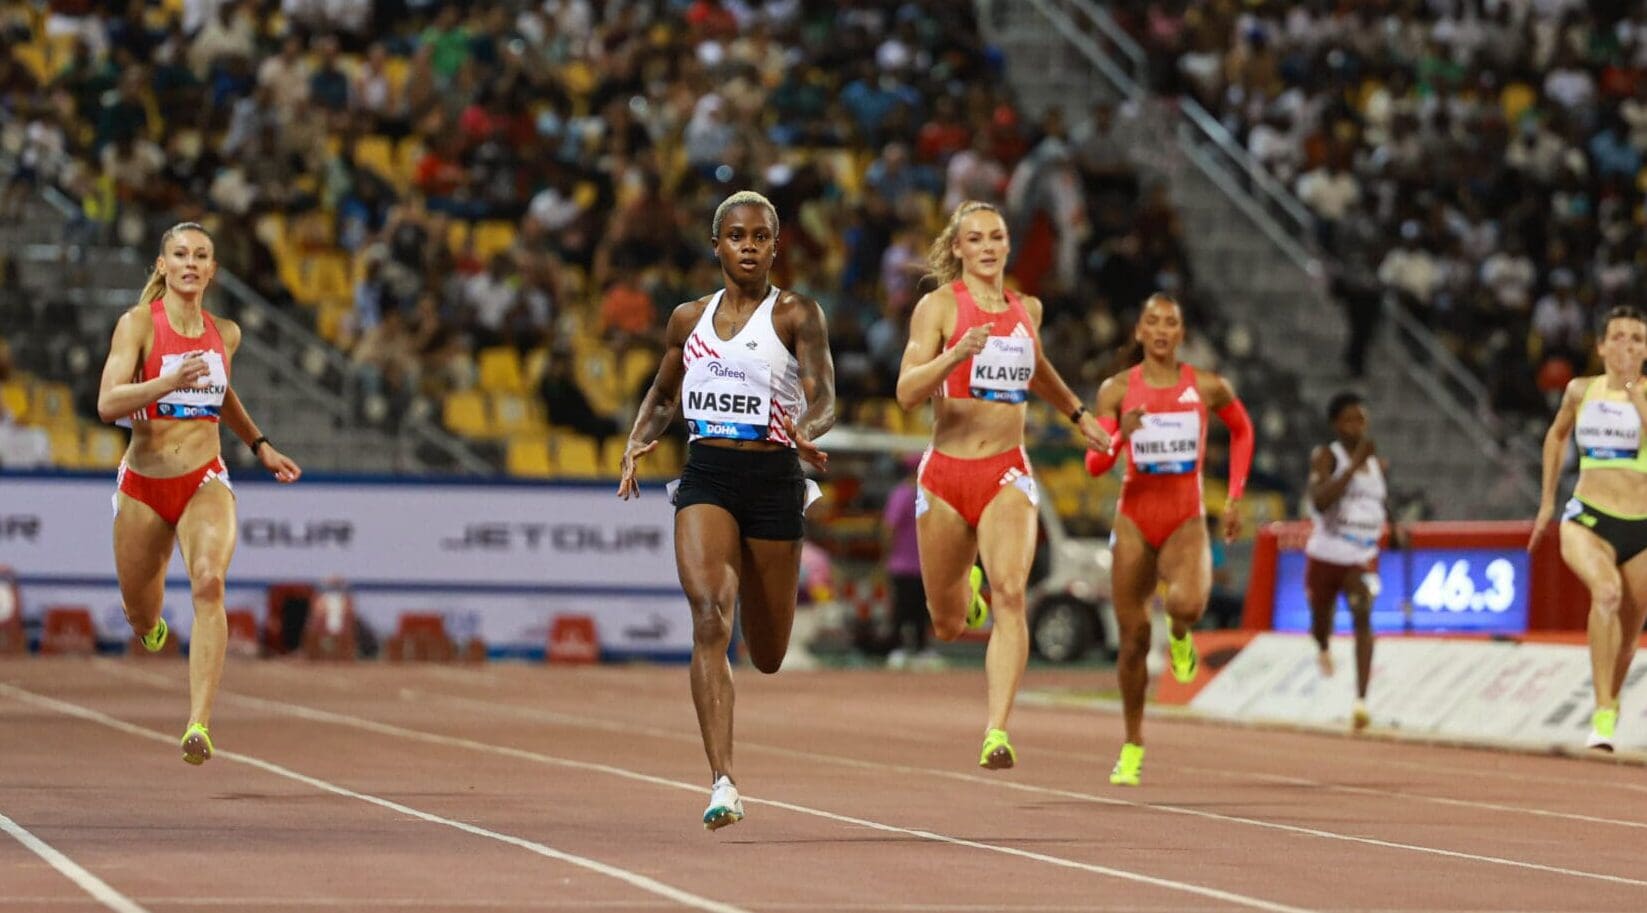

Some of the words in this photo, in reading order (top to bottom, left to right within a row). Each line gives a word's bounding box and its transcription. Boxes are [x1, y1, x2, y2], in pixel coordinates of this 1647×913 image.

[707, 361, 746, 382] Rafeeq
[975, 365, 1032, 382] KLAVER
[688, 391, 762, 415] NASER
[705, 423, 739, 435] DOHA
[1135, 440, 1196, 454] NIELSEN
[440, 522, 663, 553] JETOUR
[1412, 558, 1516, 612] 46.3
